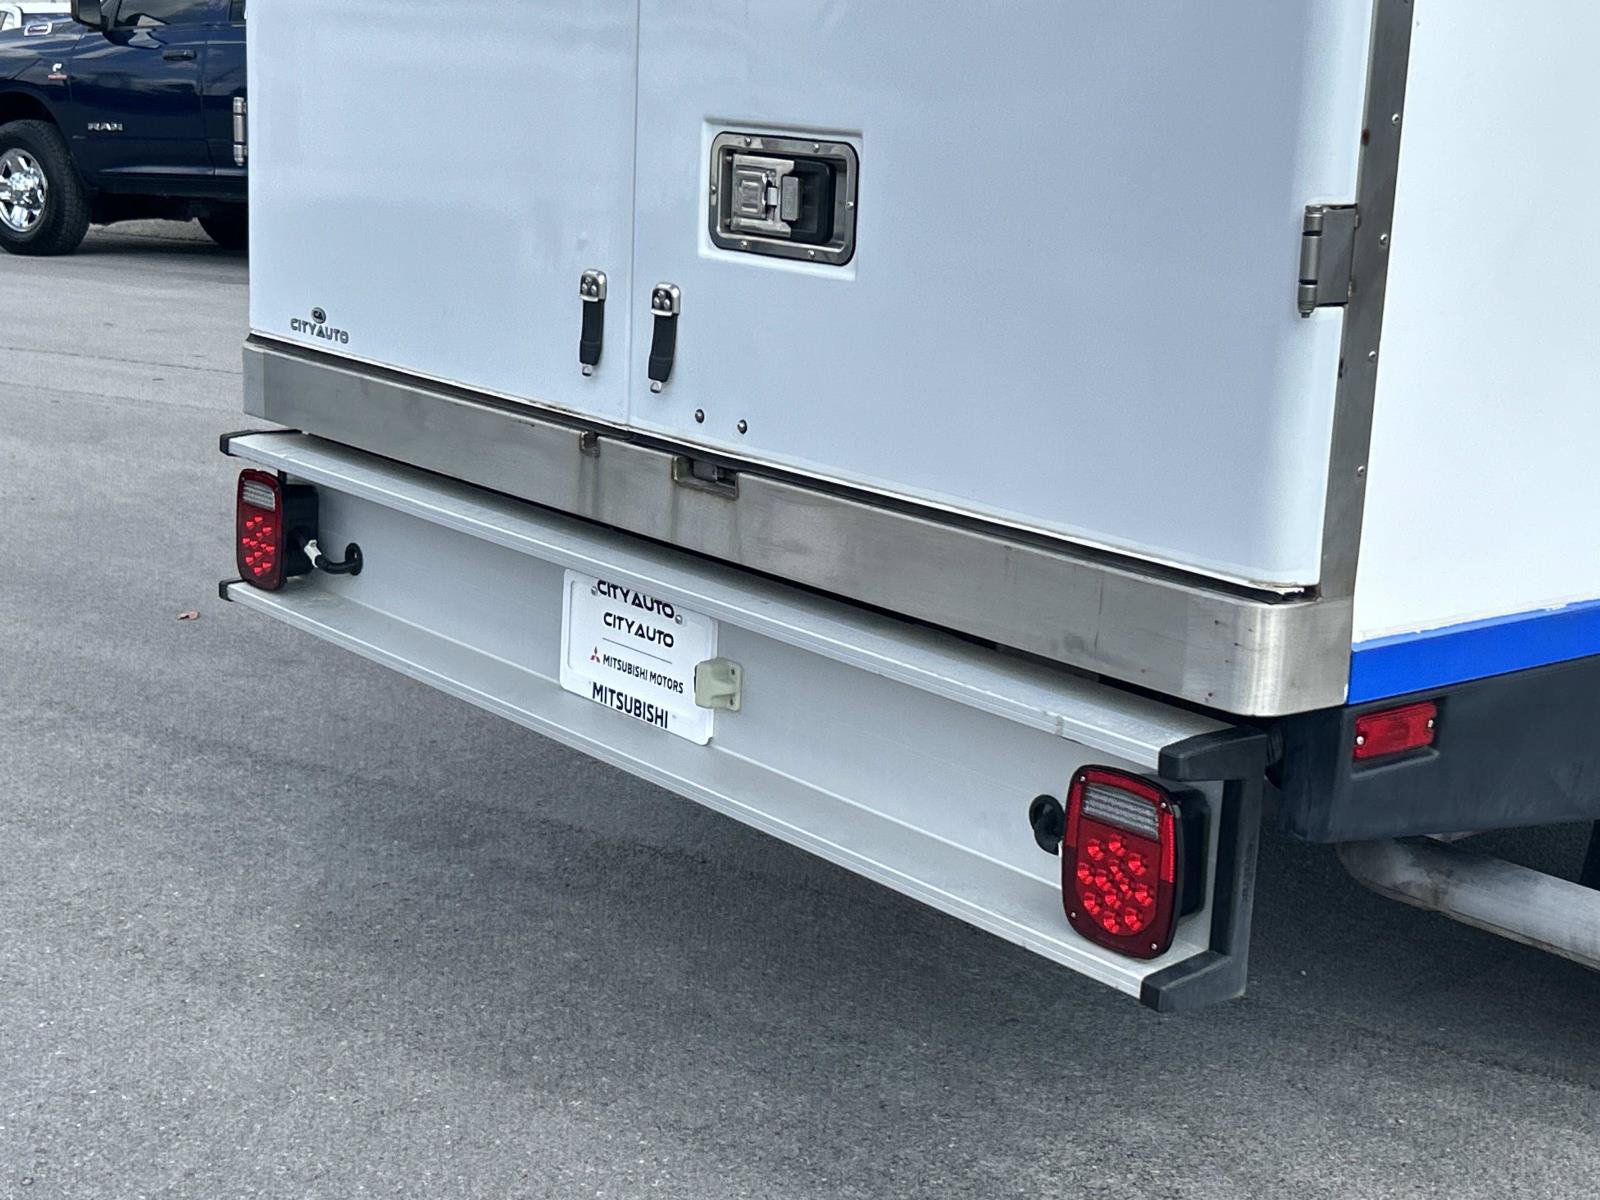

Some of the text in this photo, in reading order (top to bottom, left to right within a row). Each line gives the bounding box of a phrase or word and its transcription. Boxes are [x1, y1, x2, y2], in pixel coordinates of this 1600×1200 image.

[87, 122, 123, 131] RAM
[603, 653, 684, 694] MITSUBISHI MOTORS
[592, 681, 669, 729] MITSUBISHI
